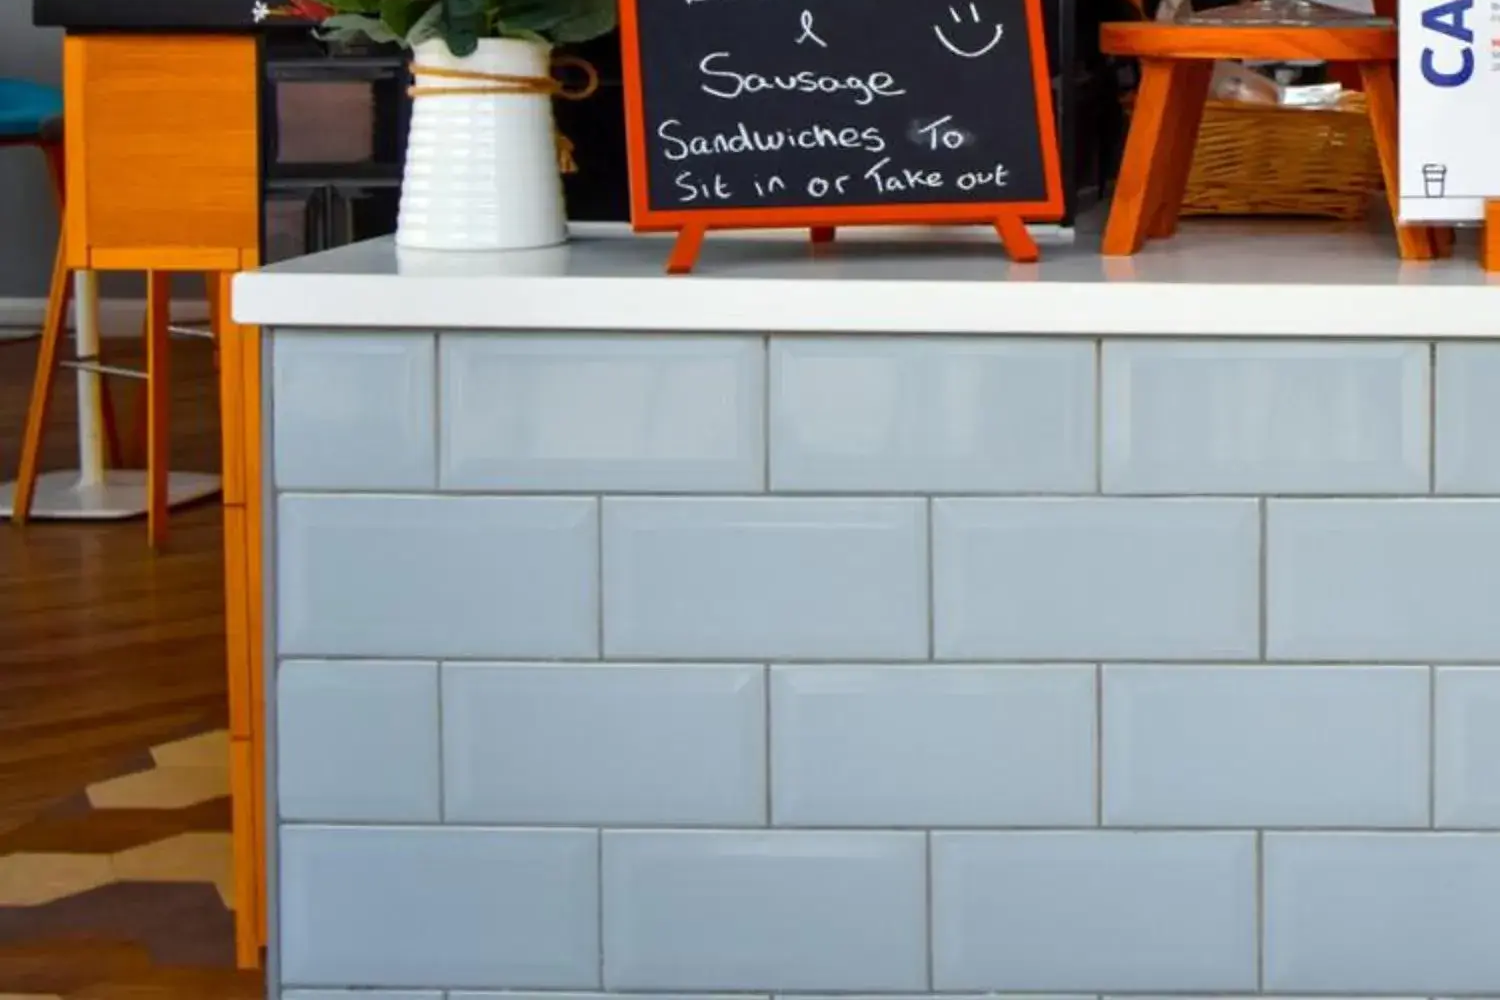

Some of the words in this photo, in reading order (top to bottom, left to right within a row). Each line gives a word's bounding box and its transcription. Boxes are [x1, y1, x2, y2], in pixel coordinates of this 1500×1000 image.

[699, 52, 906, 105] Sausage
[657, 119, 886, 161] Sandwiches
[919, 115, 965, 150] To
[675, 171, 734, 201] Sit
[754, 173, 785, 197] in
[807, 175, 851, 197] or
[864, 156, 945, 194] Take
[956, 163, 1010, 190] out
